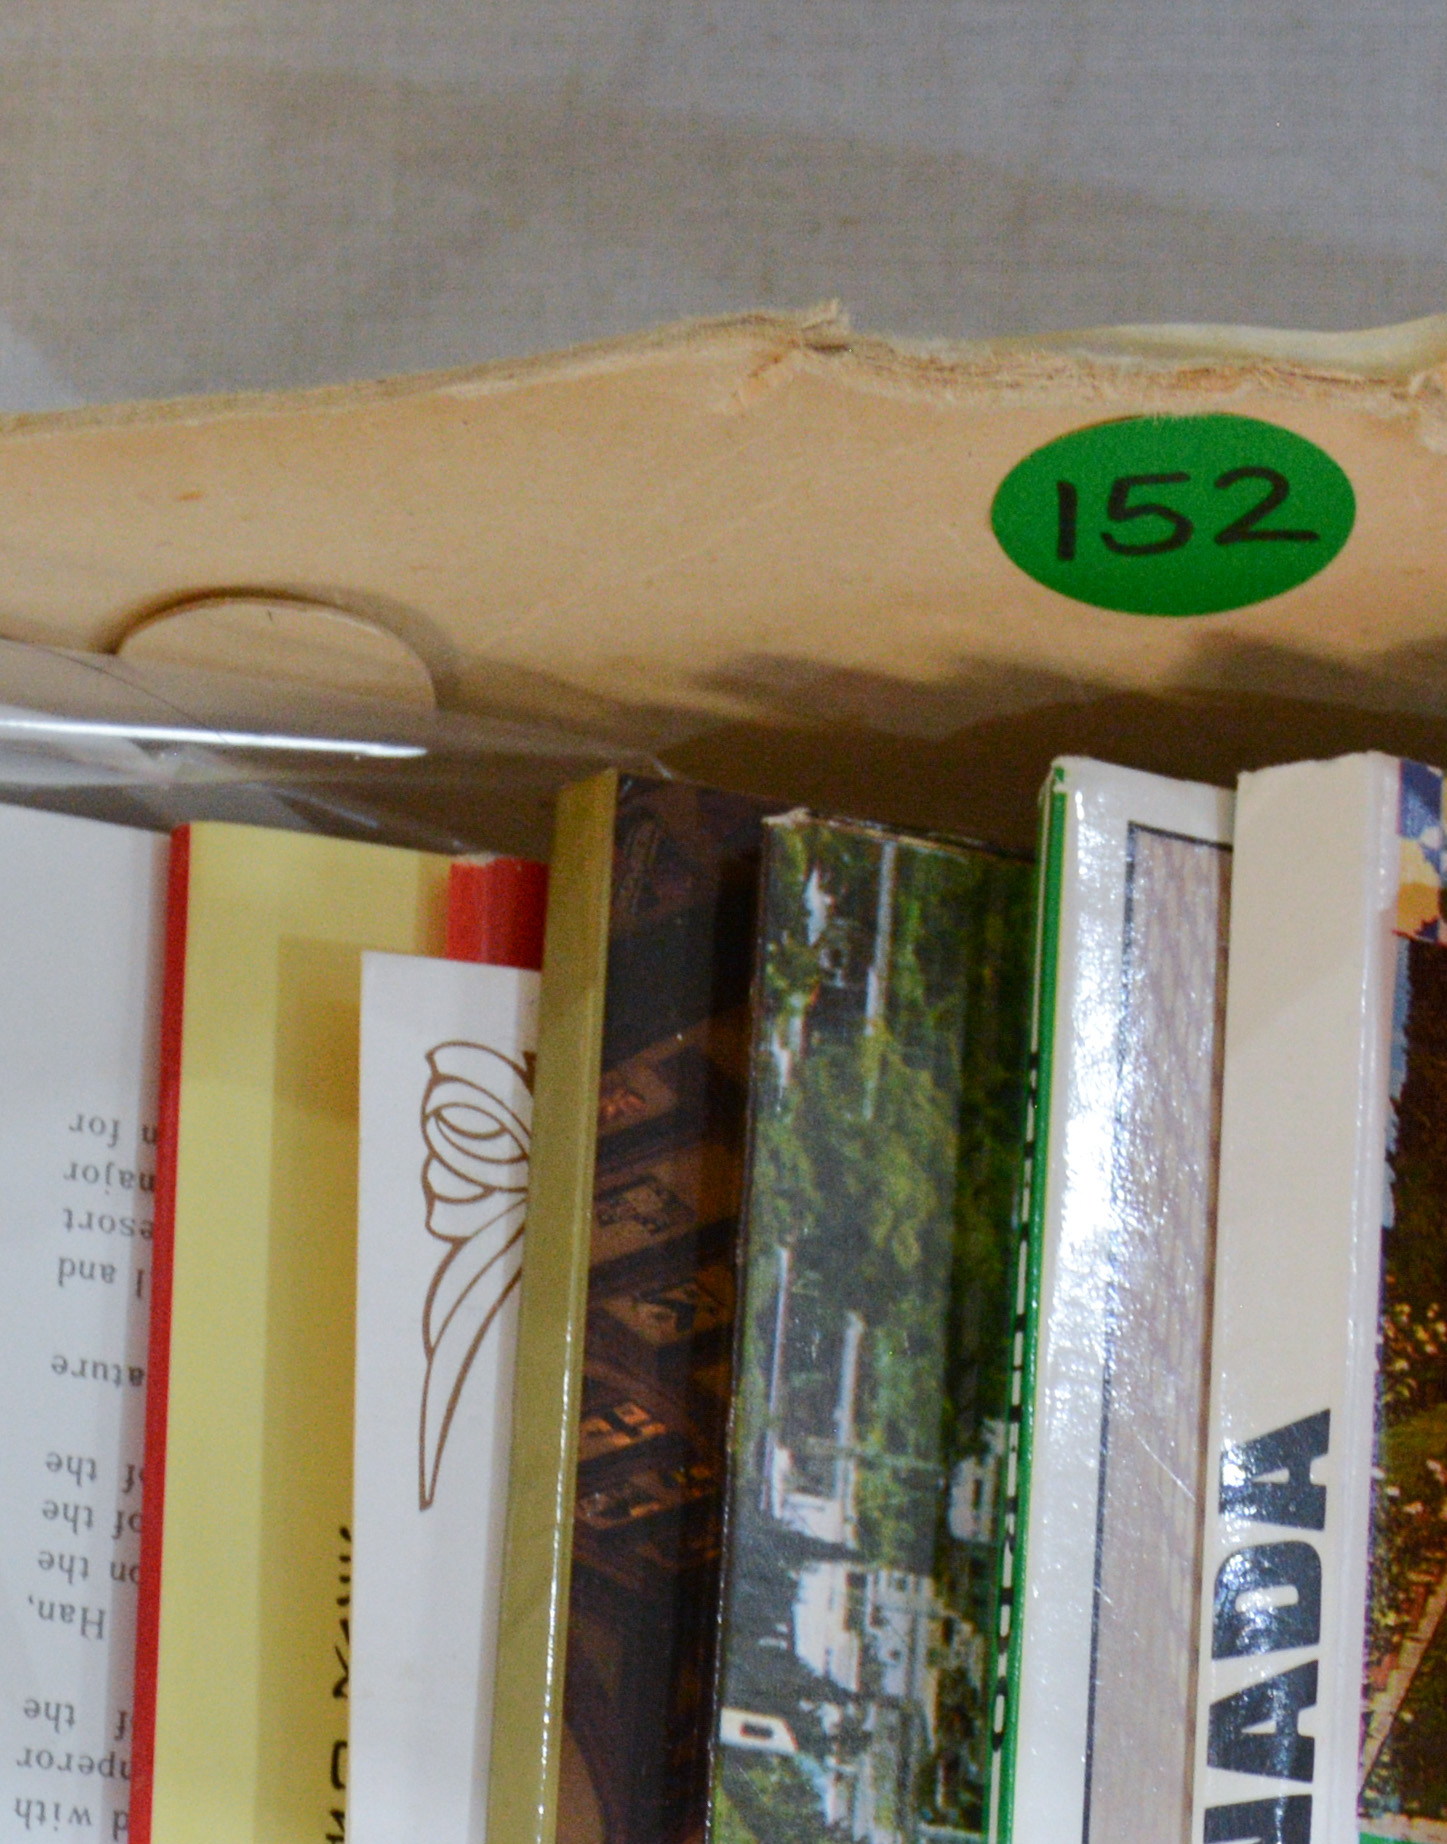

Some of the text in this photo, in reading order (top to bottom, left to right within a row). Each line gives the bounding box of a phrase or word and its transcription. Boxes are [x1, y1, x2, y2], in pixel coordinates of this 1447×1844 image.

[1055, 464, 1320, 562] 152
[69, 1113, 120, 1150] for
[58, 1255, 115, 1288] and
[45, 1451, 97, 1485] the
[41, 1499, 94, 1535] the
[37, 1550, 89, 1587] the
[27, 1594, 106, 1641] Han,
[23, 1698, 76, 1731] the
[14, 1797, 92, 1831] with
